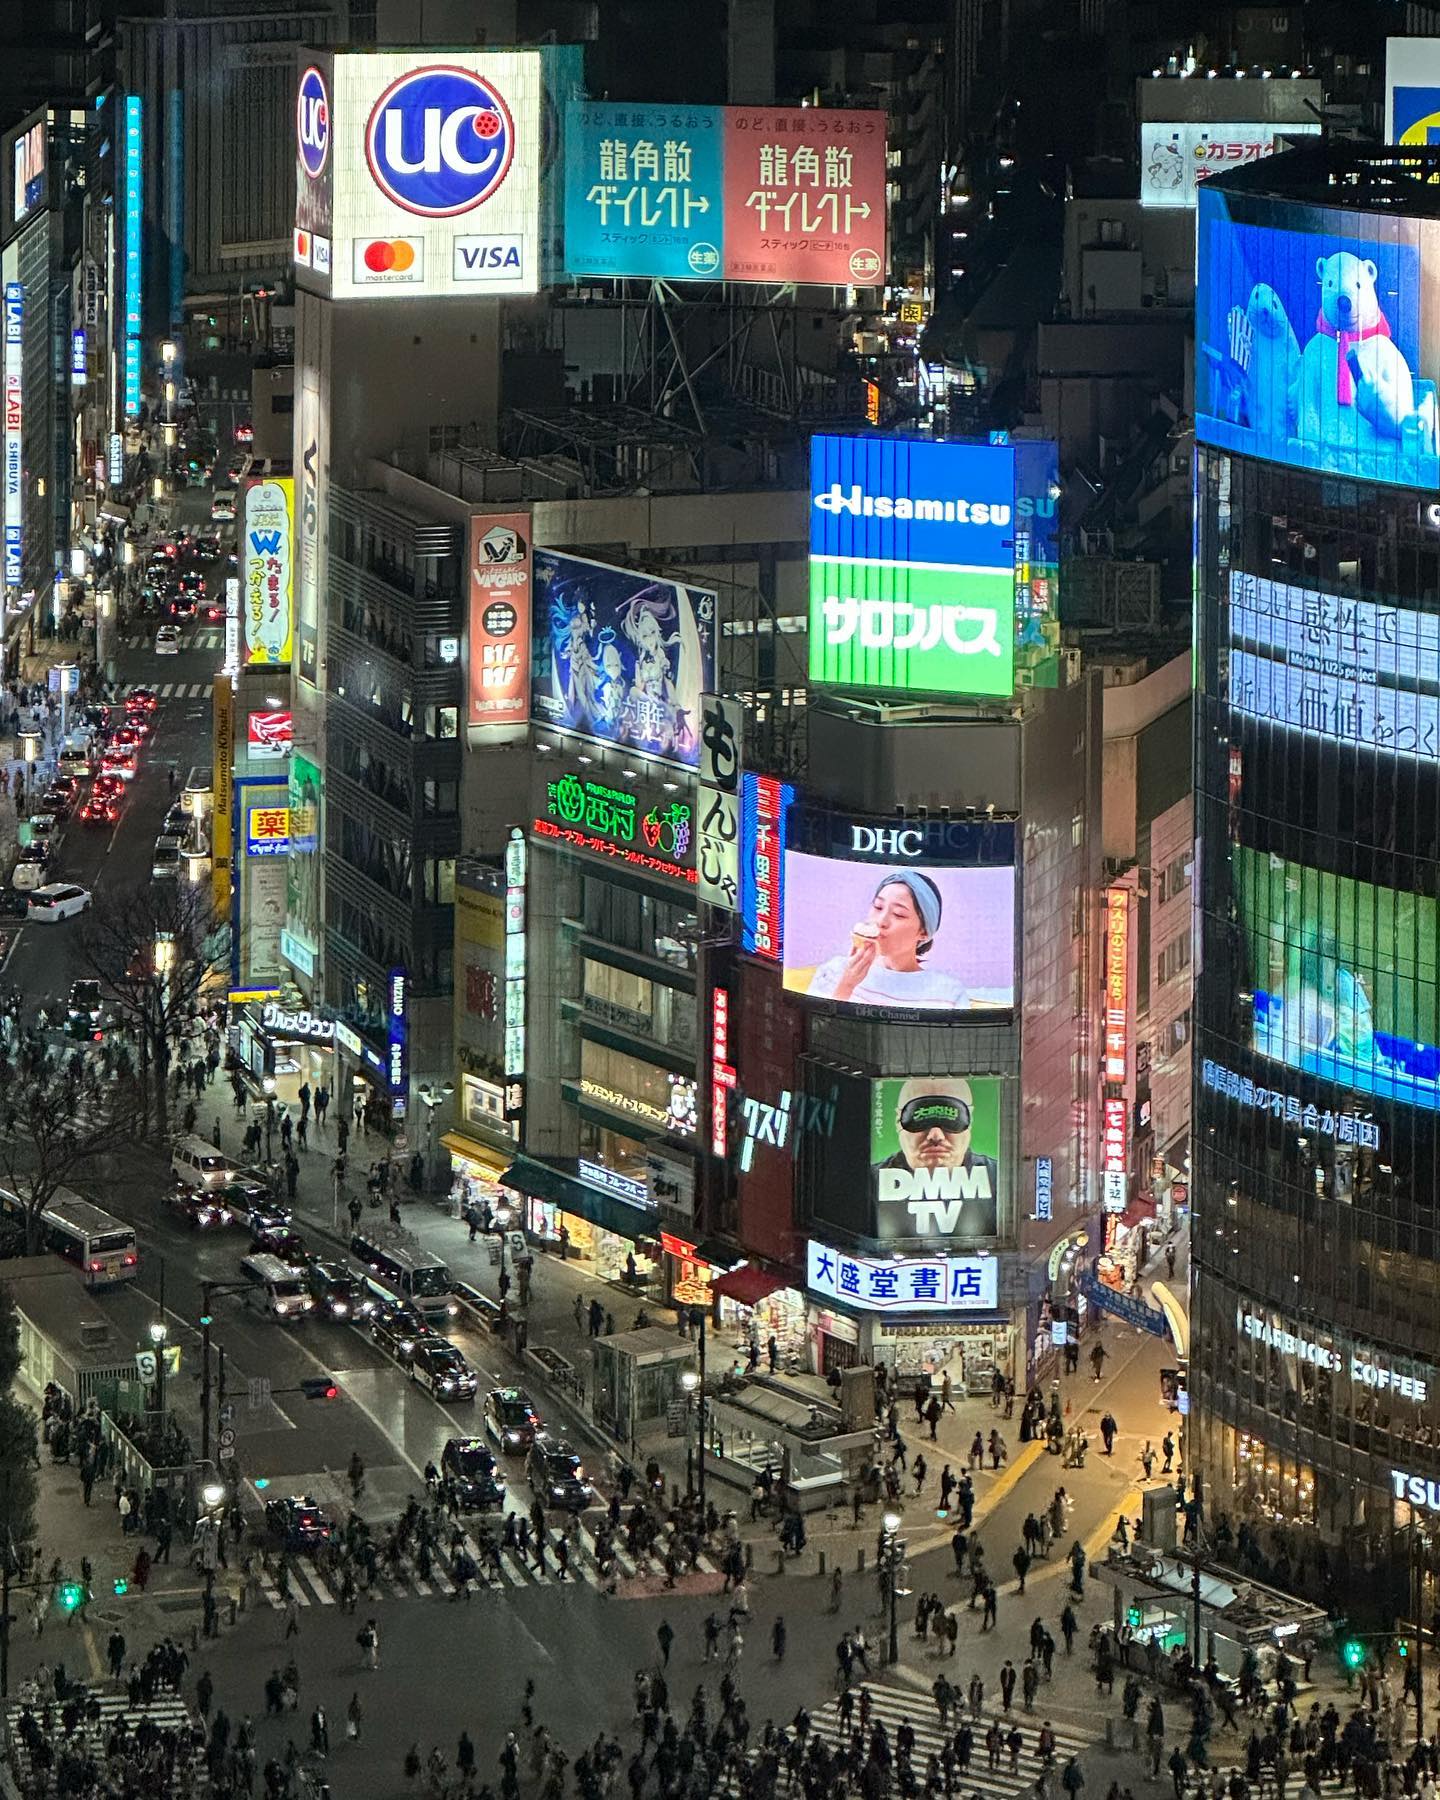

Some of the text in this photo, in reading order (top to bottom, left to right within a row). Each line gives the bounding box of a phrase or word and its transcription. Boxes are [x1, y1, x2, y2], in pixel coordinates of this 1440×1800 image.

[385, 105, 499, 175] UC
[735, 116, 876, 134] のど、直接、うるおう
[599, 139, 692, 183] 龍角散
[759, 144, 853, 188] 龍角散
[586, 185, 709, 229] ダイレクト
[745, 190, 871, 235] ダイレクト
[457, 246, 521, 268] VISA
[600, 232, 649, 245] スティック
[760, 238, 808, 251] スティック
[365, 272, 414, 282] mastercard
[7, 302, 21, 337] LABI
[7, 390, 21, 431] LABI
[8, 441, 19, 496] SHIBUYA
[813, 482, 1011, 527] Hisamitsu
[7, 546, 21, 583] LABI
[822, 595, 1001, 657] サロンパス
[1344, 664, 1377, 684] project
[217, 707, 228, 816] Matsumoto KiYoshi
[256, 810, 286, 836] 薬
[585, 796, 636, 842] 西村
[851, 825, 923, 857] DHC
[393, 976, 404, 1016] MIZUHO
[879, 1007, 920, 1022] Channel
[878, 1165, 993, 1201] DMM
[907, 1200, 963, 1234] TV
[815, 1252, 982, 1300] 大盛堂書店
[1351, 1357, 1427, 1401] COFFEE
